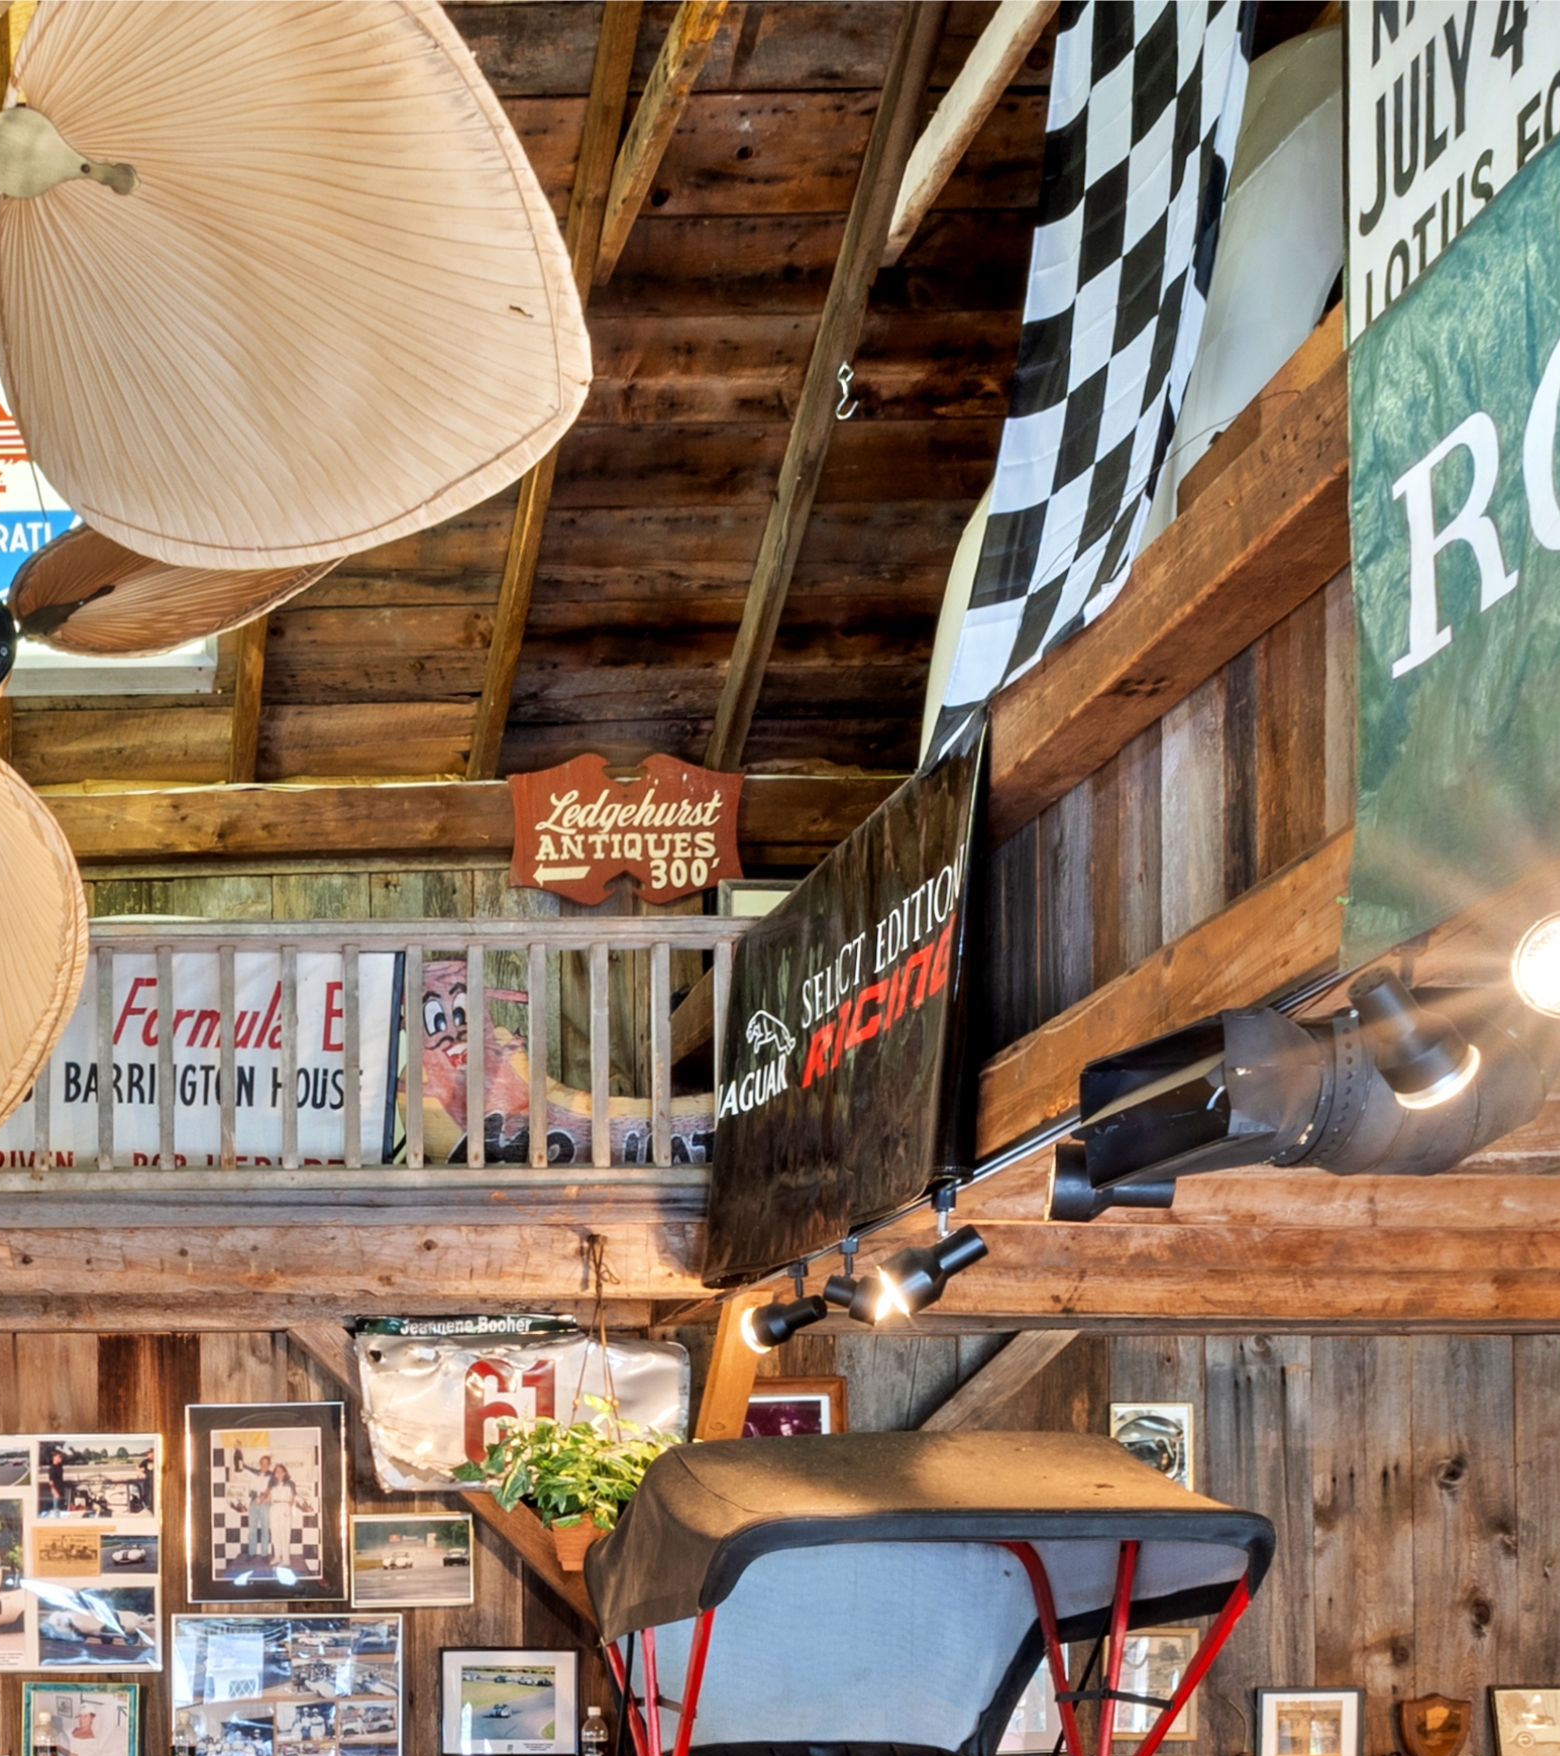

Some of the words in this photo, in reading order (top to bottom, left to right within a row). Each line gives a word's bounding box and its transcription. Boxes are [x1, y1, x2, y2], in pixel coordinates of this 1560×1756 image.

[1359, 0, 1477, 237] JULY
[535, 788, 724, 834] Ledgehurst
[534, 832, 717, 861] ANTIQUES
[873, 843, 965, 975] EDITION
[478, 1316, 533, 1334] Booher
